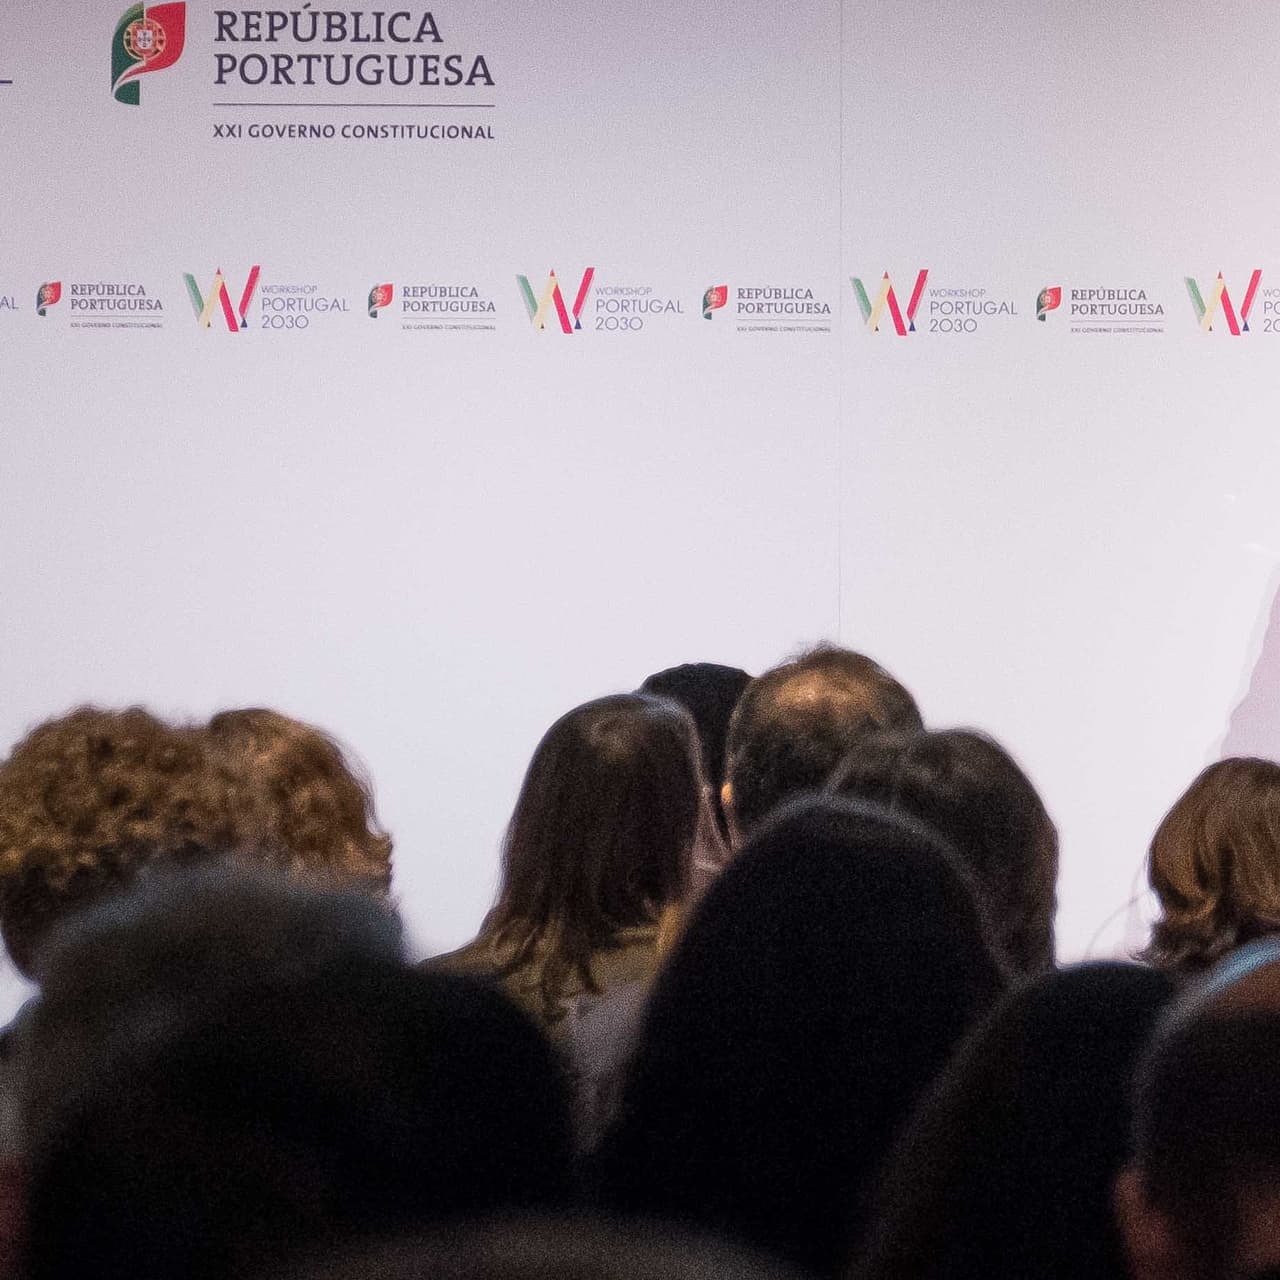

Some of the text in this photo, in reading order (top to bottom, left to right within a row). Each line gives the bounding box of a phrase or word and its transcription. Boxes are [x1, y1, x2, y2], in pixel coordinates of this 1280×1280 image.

[214, 3, 443, 43] REPÚBLICA
[214, 54, 495, 86] PORTUGUESA
[213, 124, 494, 139] XXI GOVERNO CONSTITUCIONAL
[71, 282, 146, 296] REPÚBLICA
[403, 284, 478, 297] REPÚBLICA
[738, 286, 813, 299] REPÚBLICA
[1072, 287, 1146, 300] REPÚBLICA
[71, 299, 163, 310] PORTUGUESA
[262, 297, 349, 312] PORTUGAL
[403, 301, 496, 312] PORTUGUESA
[596, 299, 684, 313] PORTUGAL
[737, 303, 831, 314] PORTUGUESA
[931, 301, 1018, 315] PORTUGAL
[1071, 304, 1164, 315] PORTUGUESA
[262, 315, 309, 329] 2030
[595, 316, 643, 331] 2030
[930, 318, 977, 332] 2030
